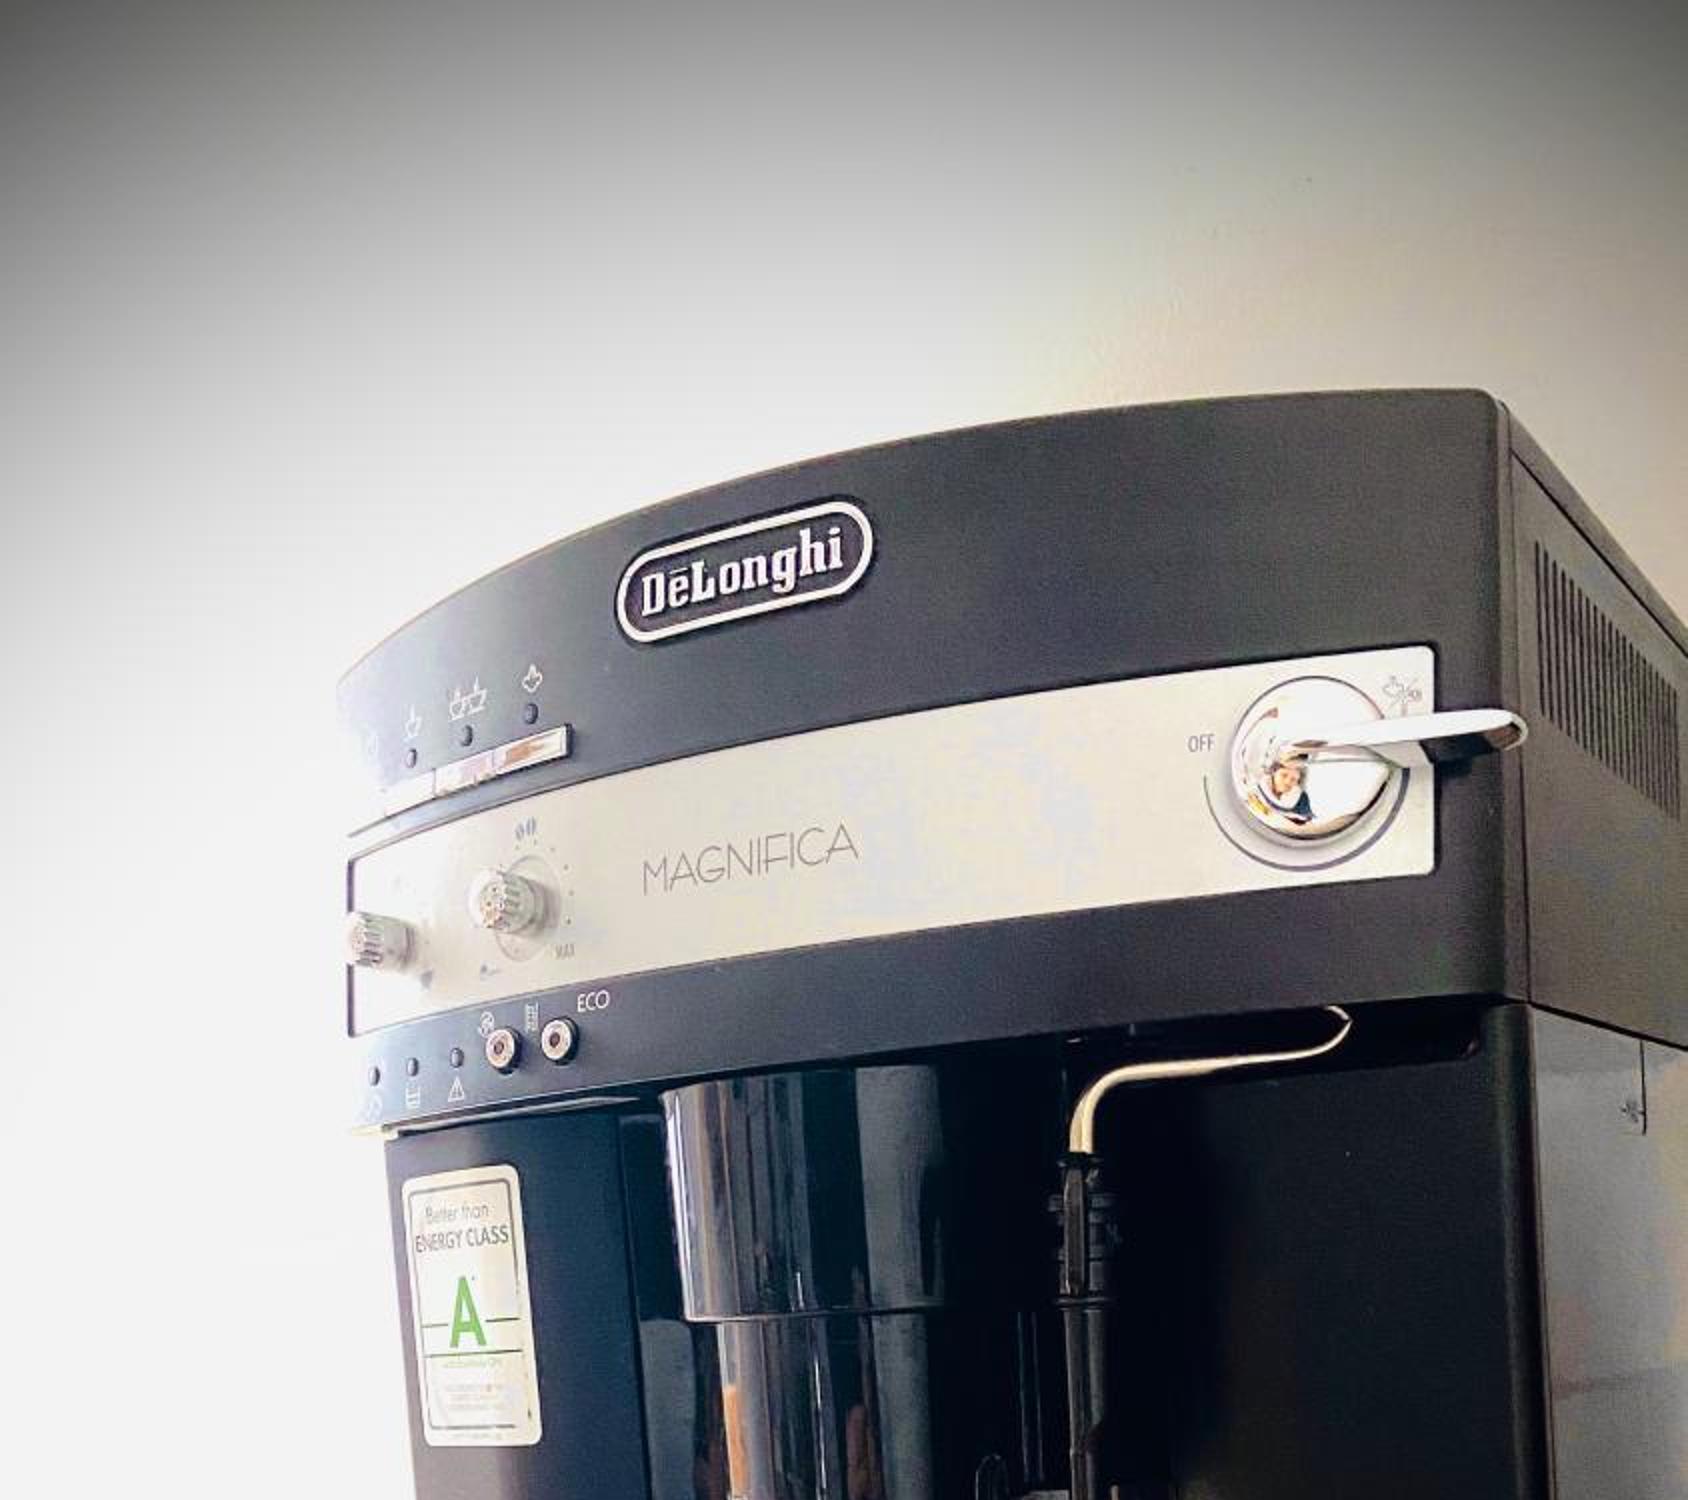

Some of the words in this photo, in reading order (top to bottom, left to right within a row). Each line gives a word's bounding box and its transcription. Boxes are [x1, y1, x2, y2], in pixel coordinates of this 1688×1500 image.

[1187, 734, 1216, 753] OFF
[642, 823, 859, 897] MAGNIFICA
[577, 989, 610, 1012] ECO
[425, 1204, 459, 1225] Better
[461, 1202, 488, 1220] than
[415, 1230, 464, 1253] ENERGY
[466, 1224, 509, 1248] CLASS
